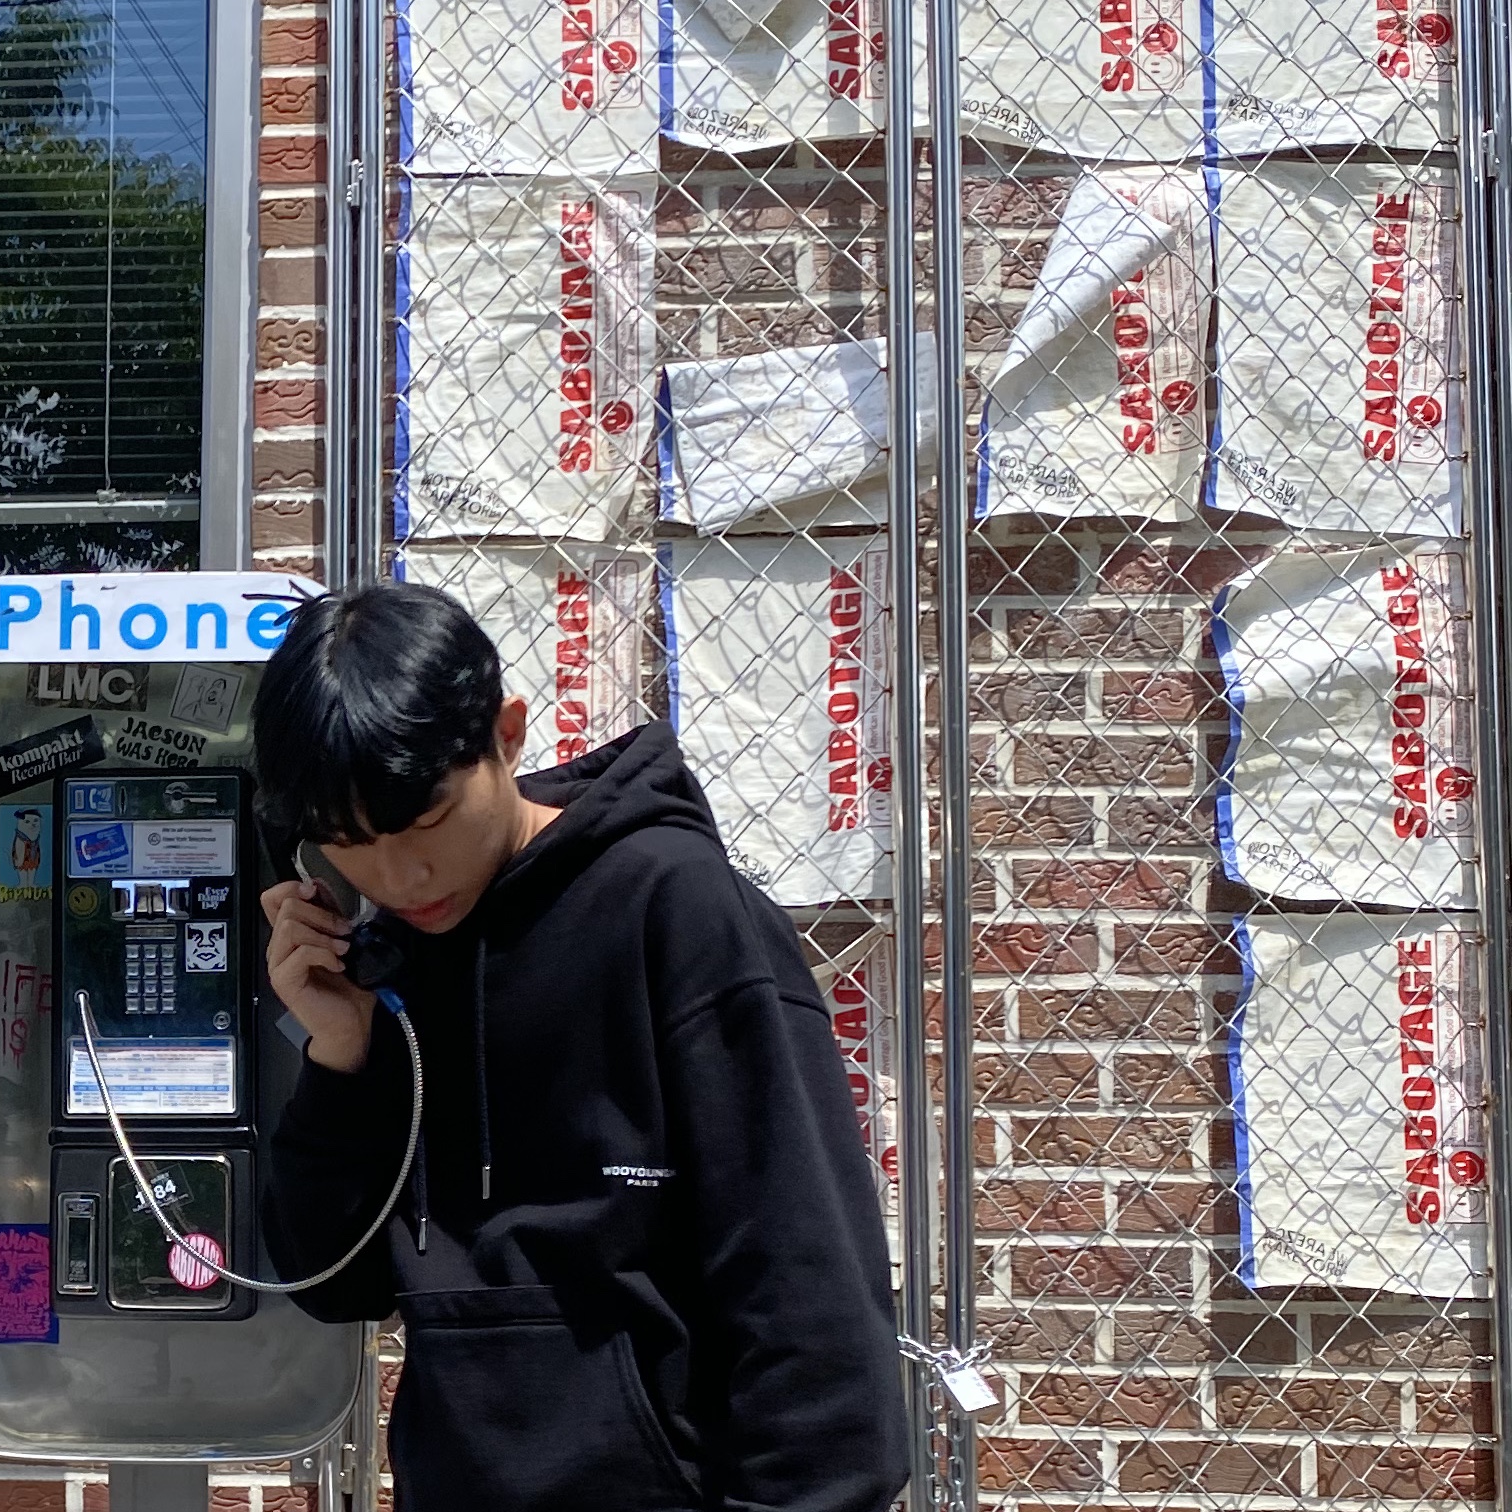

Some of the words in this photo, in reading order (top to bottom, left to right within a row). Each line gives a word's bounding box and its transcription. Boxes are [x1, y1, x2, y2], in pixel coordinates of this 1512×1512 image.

[560, 201, 593, 473] SABOTAGE
[1363, 191, 1410, 461] SABOTAGE
[0, 729, 85, 772] kompakt
[38, 665, 135, 704] LMC
[555, 570, 589, 765] BOTAGE
[828, 561, 862, 831] SABOTAGE
[1383, 565, 1428, 839] SABOTAGE
[11, 756, 56, 784] Record
[58, 748, 84, 769] Bar
[601, 1166, 676, 1178] WOOYOUN
[1398, 940, 1440, 1224] SABOTAGE
[134, 1179, 177, 1205] 184
